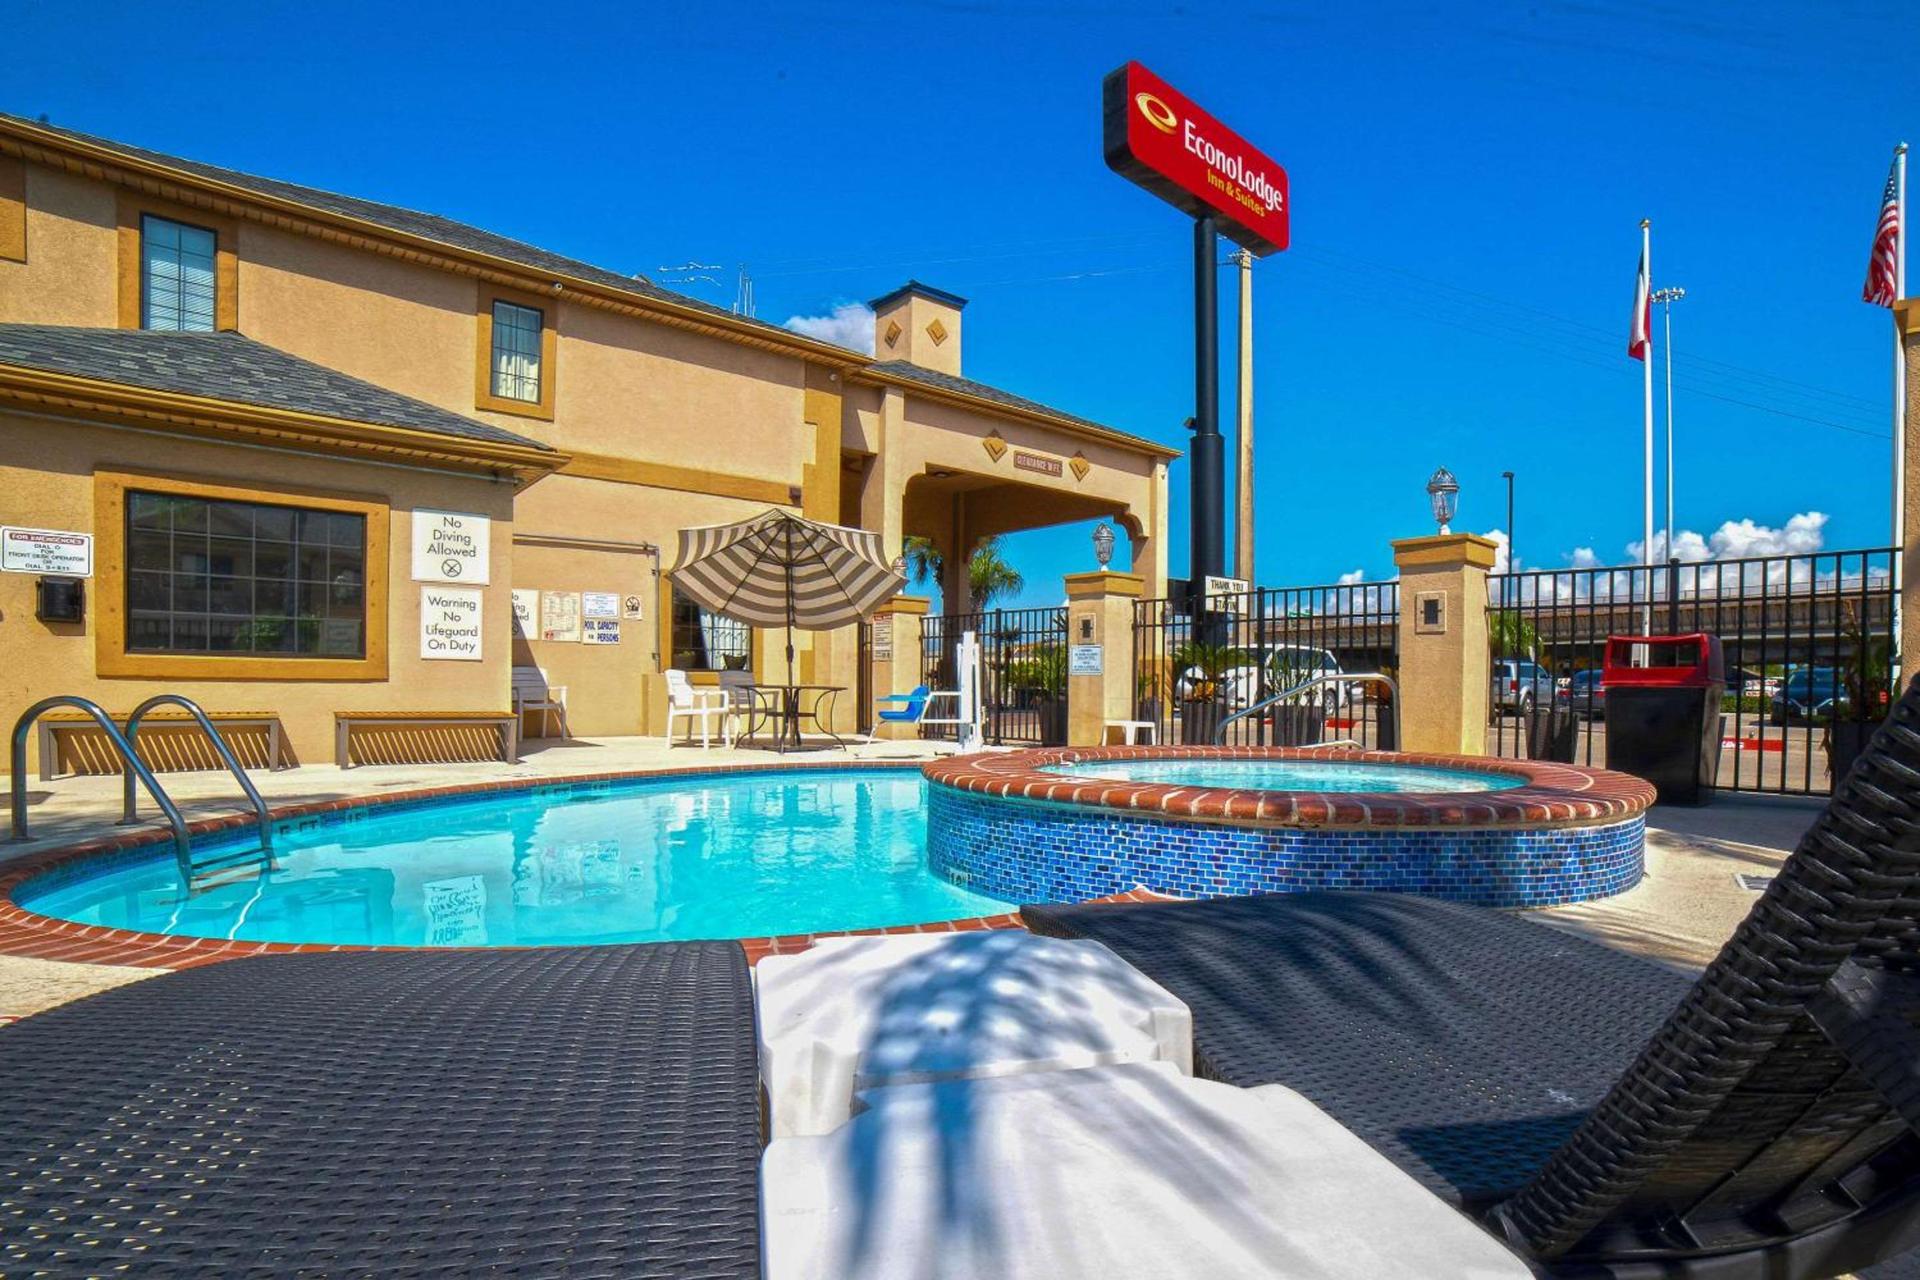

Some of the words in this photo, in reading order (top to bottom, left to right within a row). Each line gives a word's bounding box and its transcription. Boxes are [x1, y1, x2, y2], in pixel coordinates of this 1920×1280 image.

[1184, 118, 1282, 212] EconoLodge
[1207, 168, 1225, 192] Inn
[1225, 181, 1235, 198] &
[1235, 190, 1265, 217] Suites
[443, 516, 462, 528] No
[432, 529, 472, 546] Diving
[8, 551, 31, 559] FRONT
[426, 543, 477, 558] Allowed
[1211, 580, 1231, 591] THANK
[1232, 582, 1244, 592] YOU
[428, 596, 477, 612] Warning
[443, 612, 462, 623] No
[425, 624, 478, 639] Lifeguard
[428, 639, 447, 651] On
[450, 640, 476, 653] Duty
